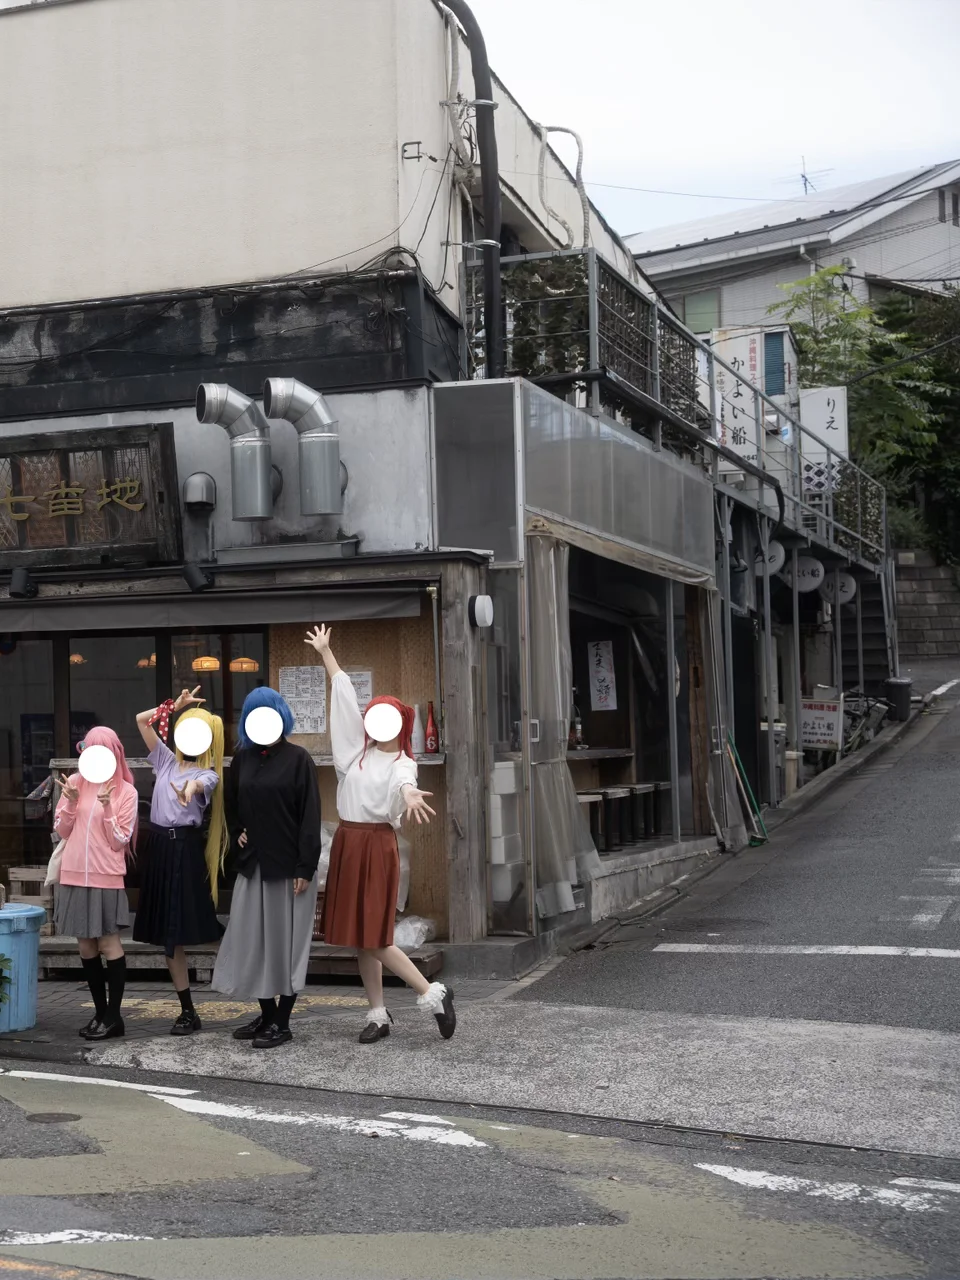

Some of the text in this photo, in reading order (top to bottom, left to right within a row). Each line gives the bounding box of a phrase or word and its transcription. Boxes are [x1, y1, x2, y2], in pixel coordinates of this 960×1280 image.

[731, 357, 747, 445] かよい船
[826, 397, 839, 430] りえ
